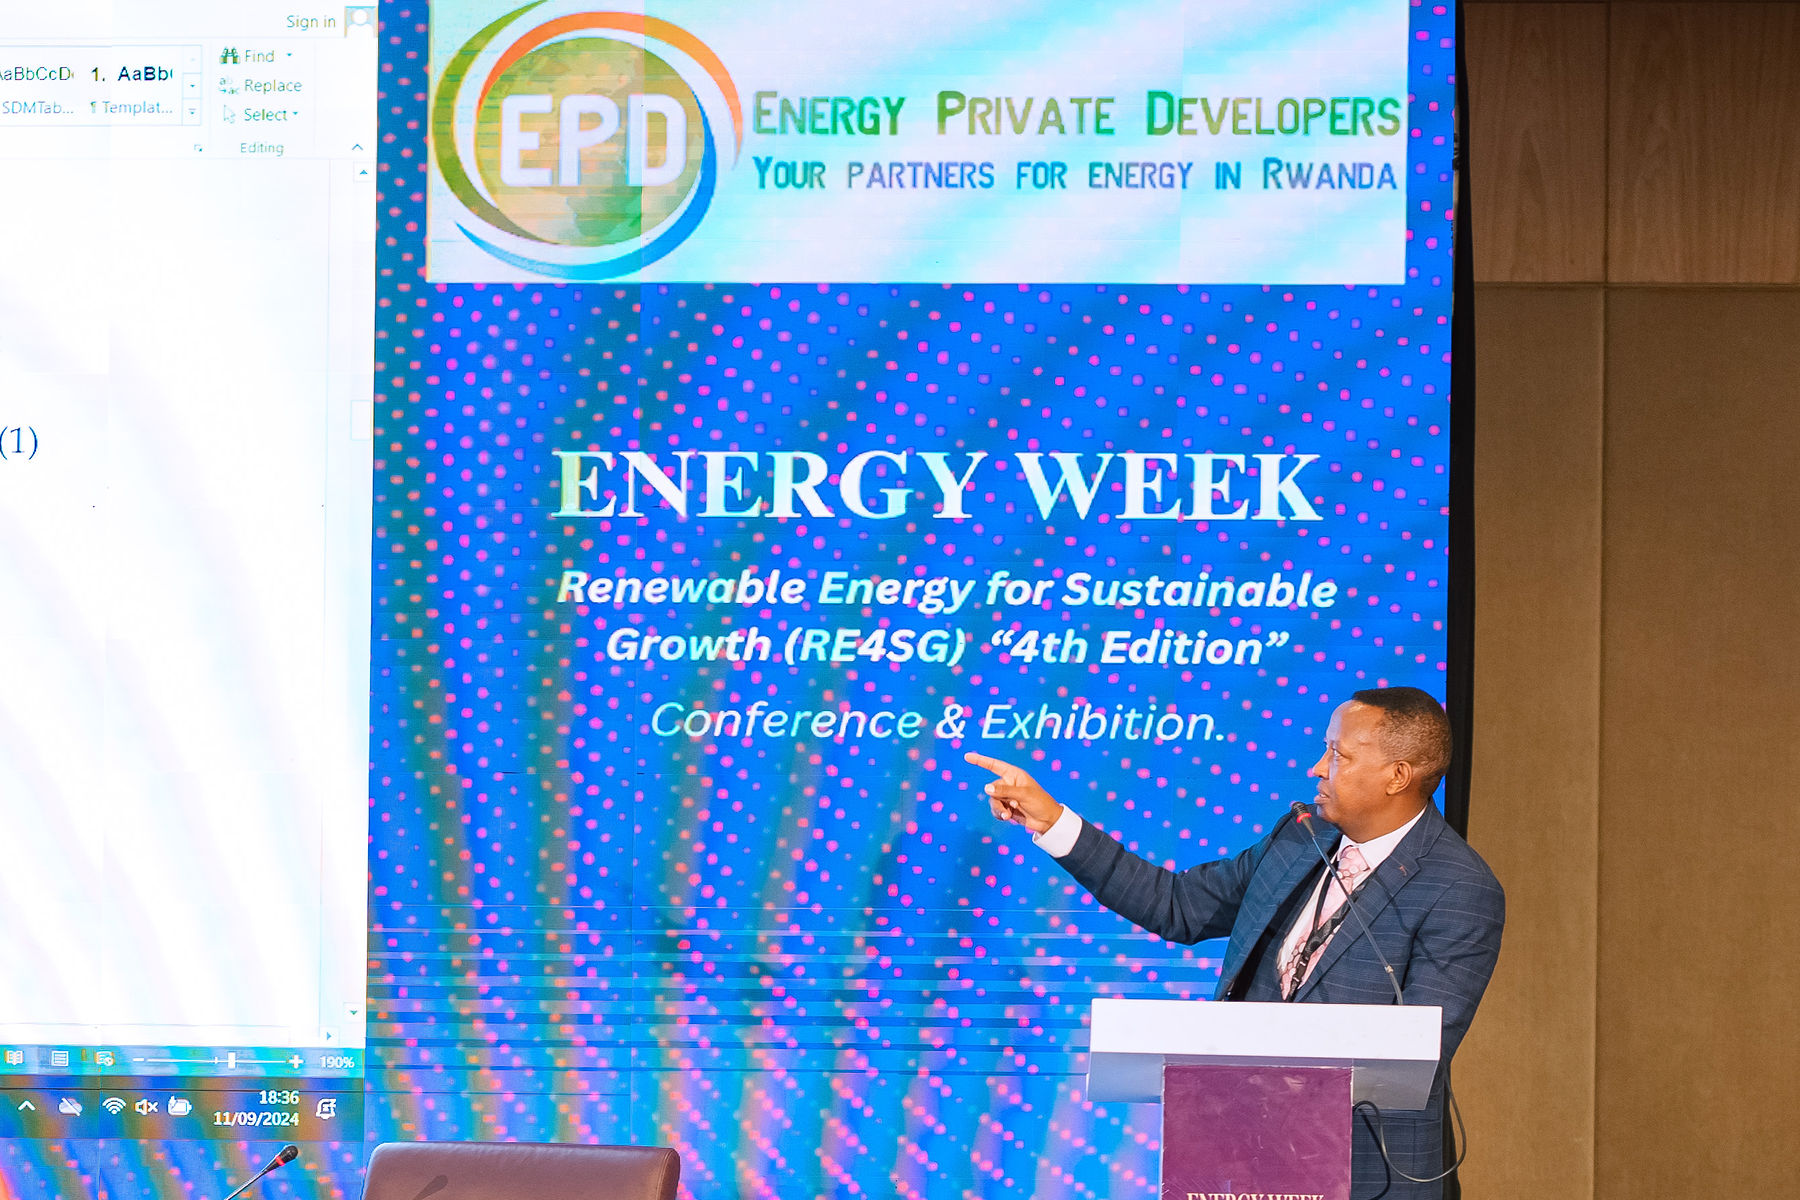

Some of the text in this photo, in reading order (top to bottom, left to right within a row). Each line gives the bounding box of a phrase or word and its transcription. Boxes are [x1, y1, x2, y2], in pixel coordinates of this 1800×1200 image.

[287, 15, 336, 32] Sign in
[245, 50, 275, 63] Find
[245, 79, 303, 95] Replace
[244, 108, 288, 122] Select
[754, 90, 1402, 137] ENERGY PRIVATE DEVELOPERS
[499, 94, 689, 187] EPD
[241, 142, 284, 157] Editing
[753, 155, 1398, 190] YOUR PARTNERS FOR ENERGY IN RWANDA
[551, 450, 1323, 522] ENERGY WEEK
[557, 570, 1338, 612] Renewable Energy for Sustainable
[607, 626, 1289, 668] Growth (RE4SG) “4th Edition”
[650, 700, 1227, 743] Conference & Exhibition.
[319, 1055, 356, 1070] 190%
[259, 1090, 300, 1104] 18:36
[213, 1111, 300, 1127] 11/09/2024
